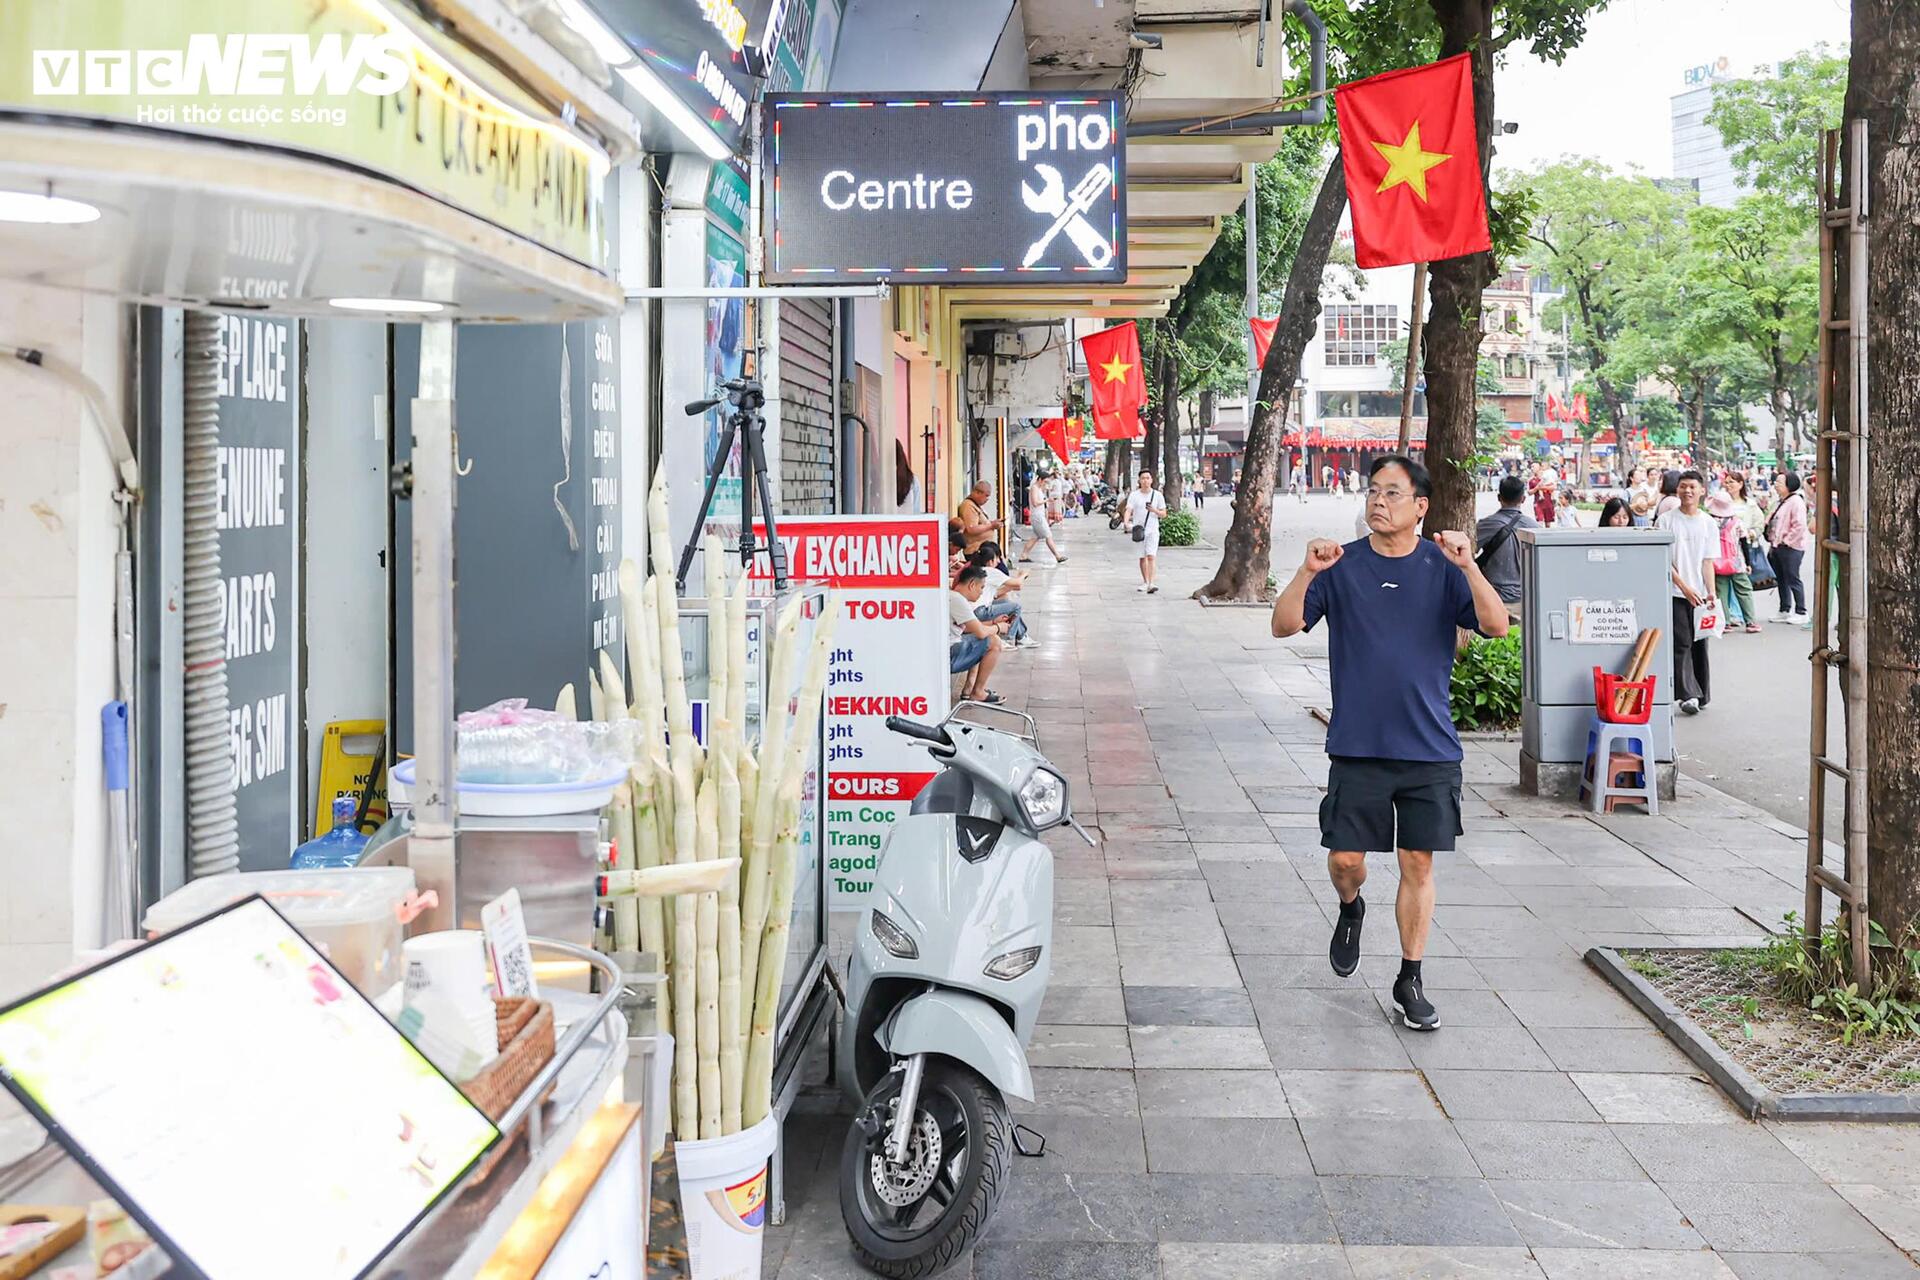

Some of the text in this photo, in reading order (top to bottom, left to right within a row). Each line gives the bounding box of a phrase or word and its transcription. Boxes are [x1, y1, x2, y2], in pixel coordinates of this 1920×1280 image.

[1017, 103, 1110, 161] pho
[821, 170, 973, 210] Centre
[754, 534, 930, 577] NY EXCHANGE
[845, 600, 916, 620] TOUR
[256, 693, 286, 781] SIM
[859, 807, 896, 823] Coc
[829, 831, 881, 849] Trang
[829, 855, 879, 873] agod
